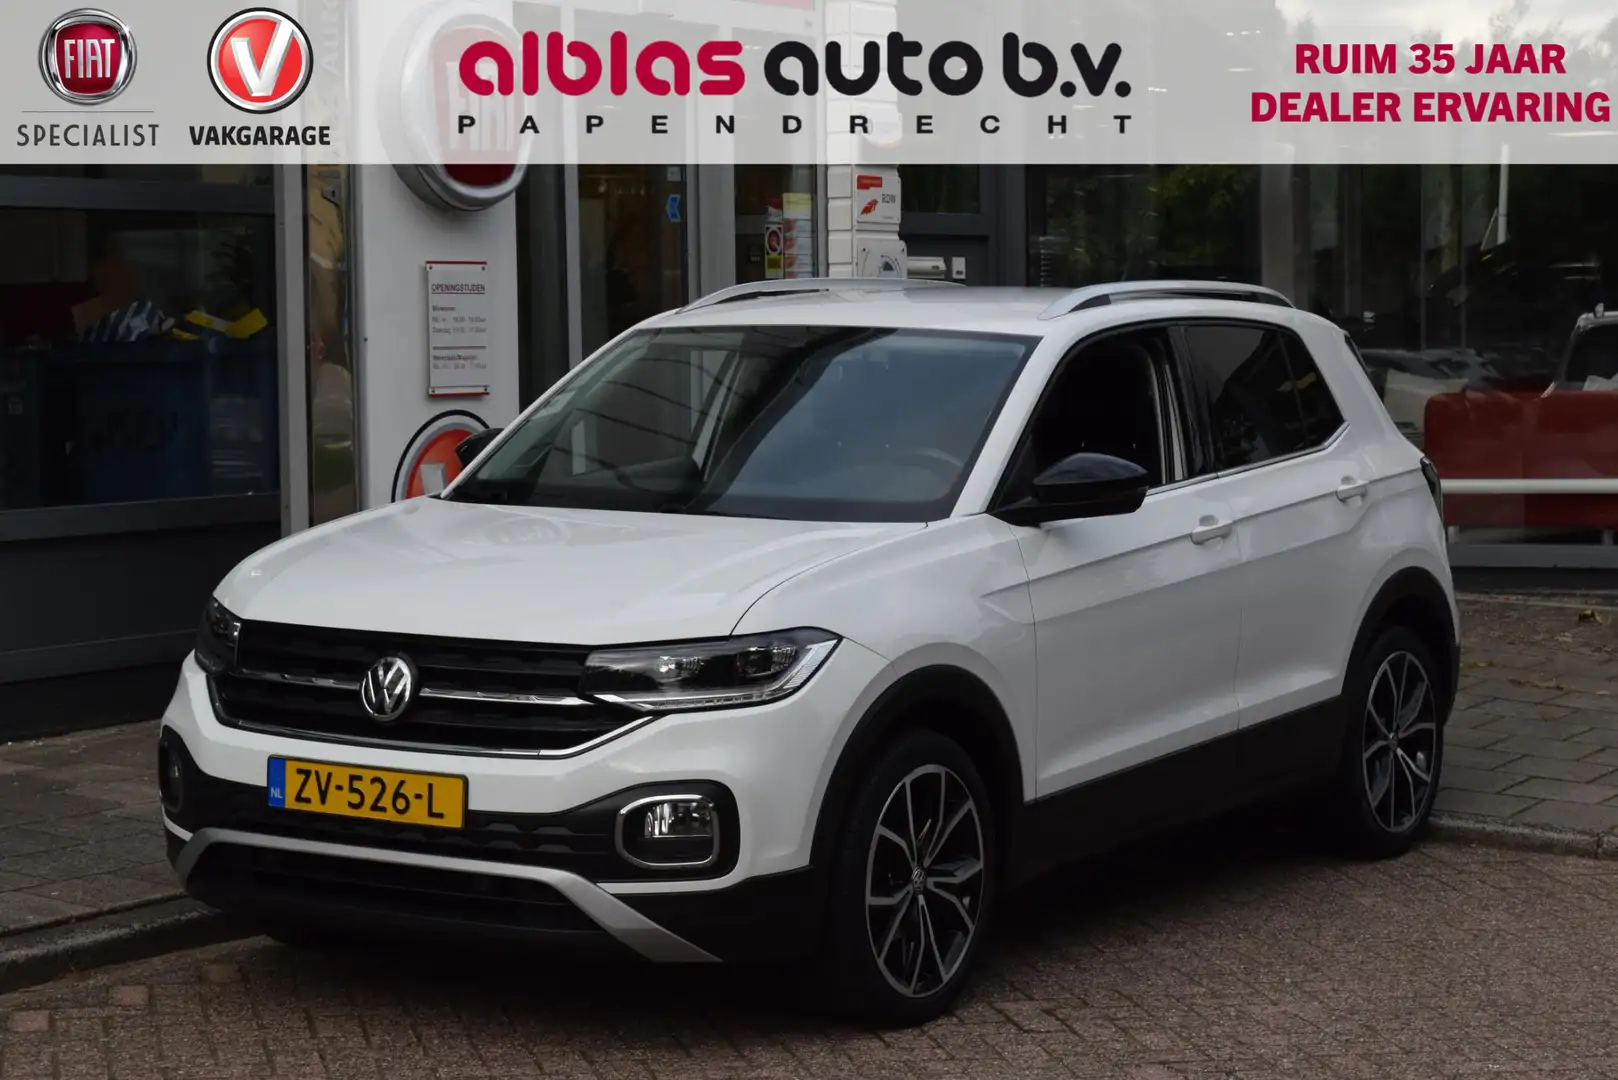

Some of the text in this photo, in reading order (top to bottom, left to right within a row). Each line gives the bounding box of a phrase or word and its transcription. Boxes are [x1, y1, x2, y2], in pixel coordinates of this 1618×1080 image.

[431, 284, 486, 292] OPENINGSTIJDEN
[270, 787, 284, 799] NL
[295, 767, 445, 820] ZV-526-L
